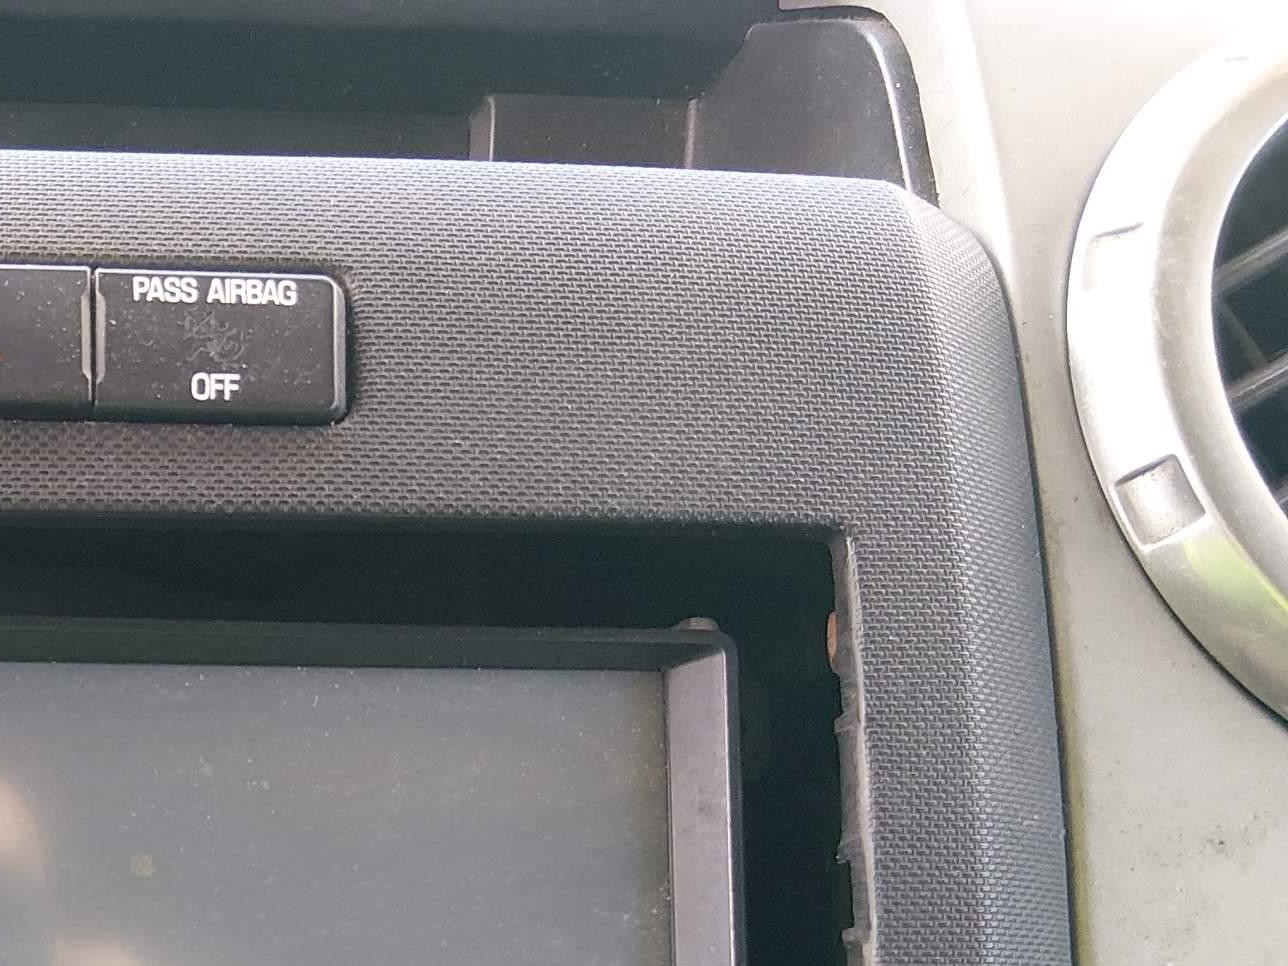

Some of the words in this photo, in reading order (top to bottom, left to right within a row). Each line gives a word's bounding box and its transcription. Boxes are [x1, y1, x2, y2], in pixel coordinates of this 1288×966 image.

[132, 276, 198, 303] PASS
[207, 278, 297, 306] AIRBAG
[190, 372, 241, 401] OFF
